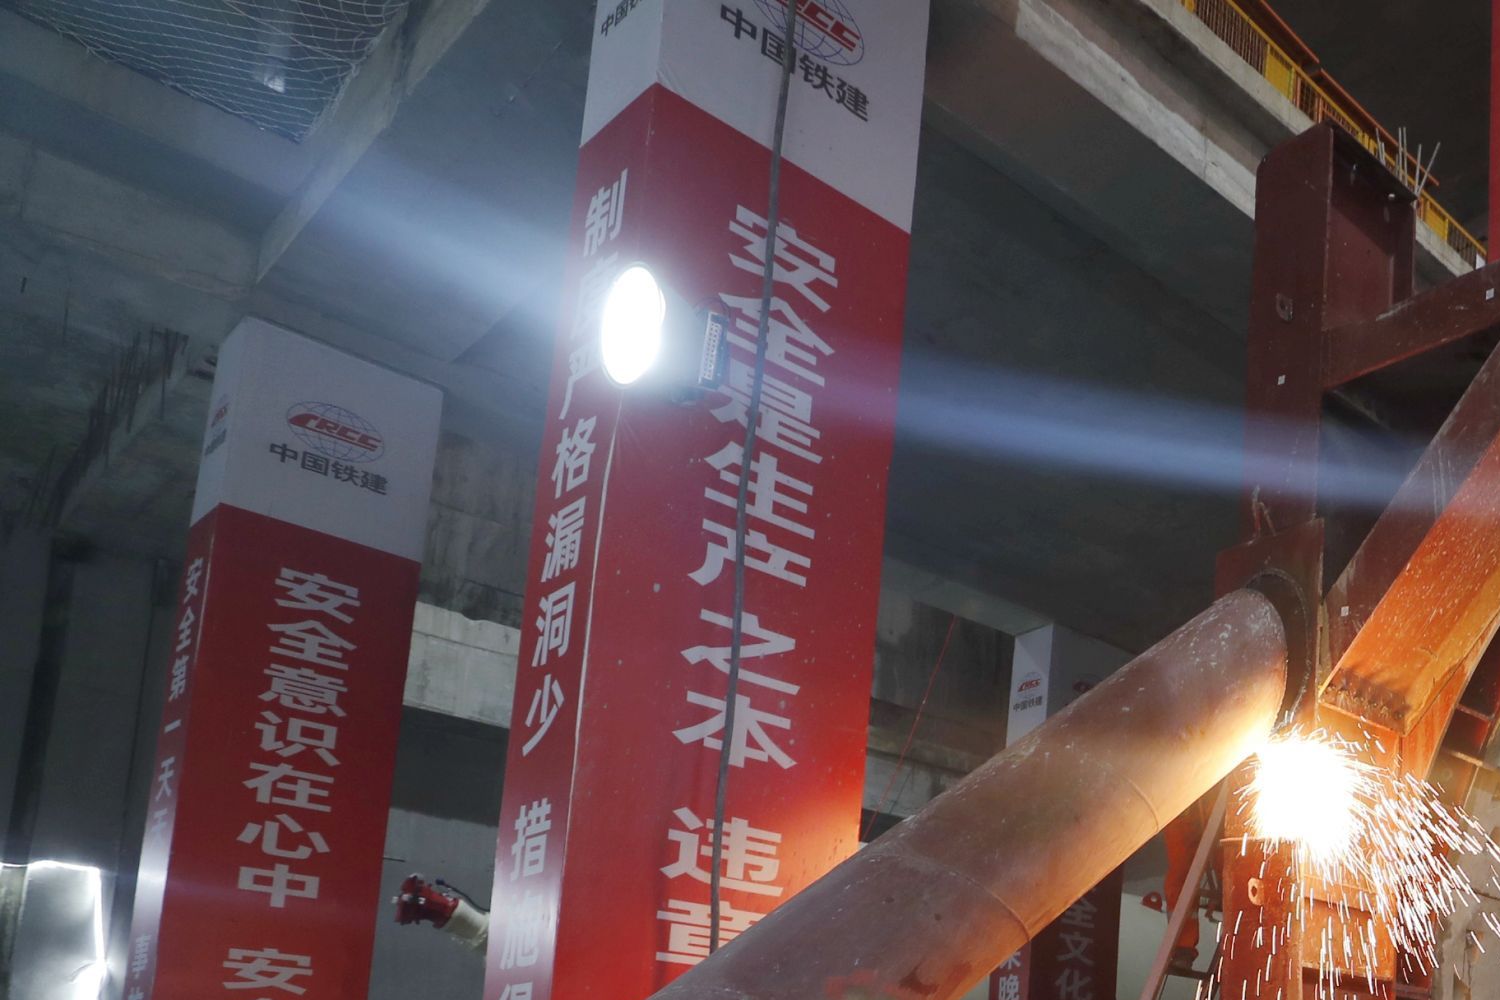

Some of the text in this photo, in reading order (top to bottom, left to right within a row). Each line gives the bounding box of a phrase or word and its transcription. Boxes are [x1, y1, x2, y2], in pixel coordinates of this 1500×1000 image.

[601, 0, 638, 37] 中国
[720, 4, 869, 122] 中国铁建
[269, 443, 389, 496] 中国铁建
[289, 412, 382, 451] CRCC
[672, 204, 838, 770] 安全是生产之本
[236, 567, 360, 908] 安全意识在心中
